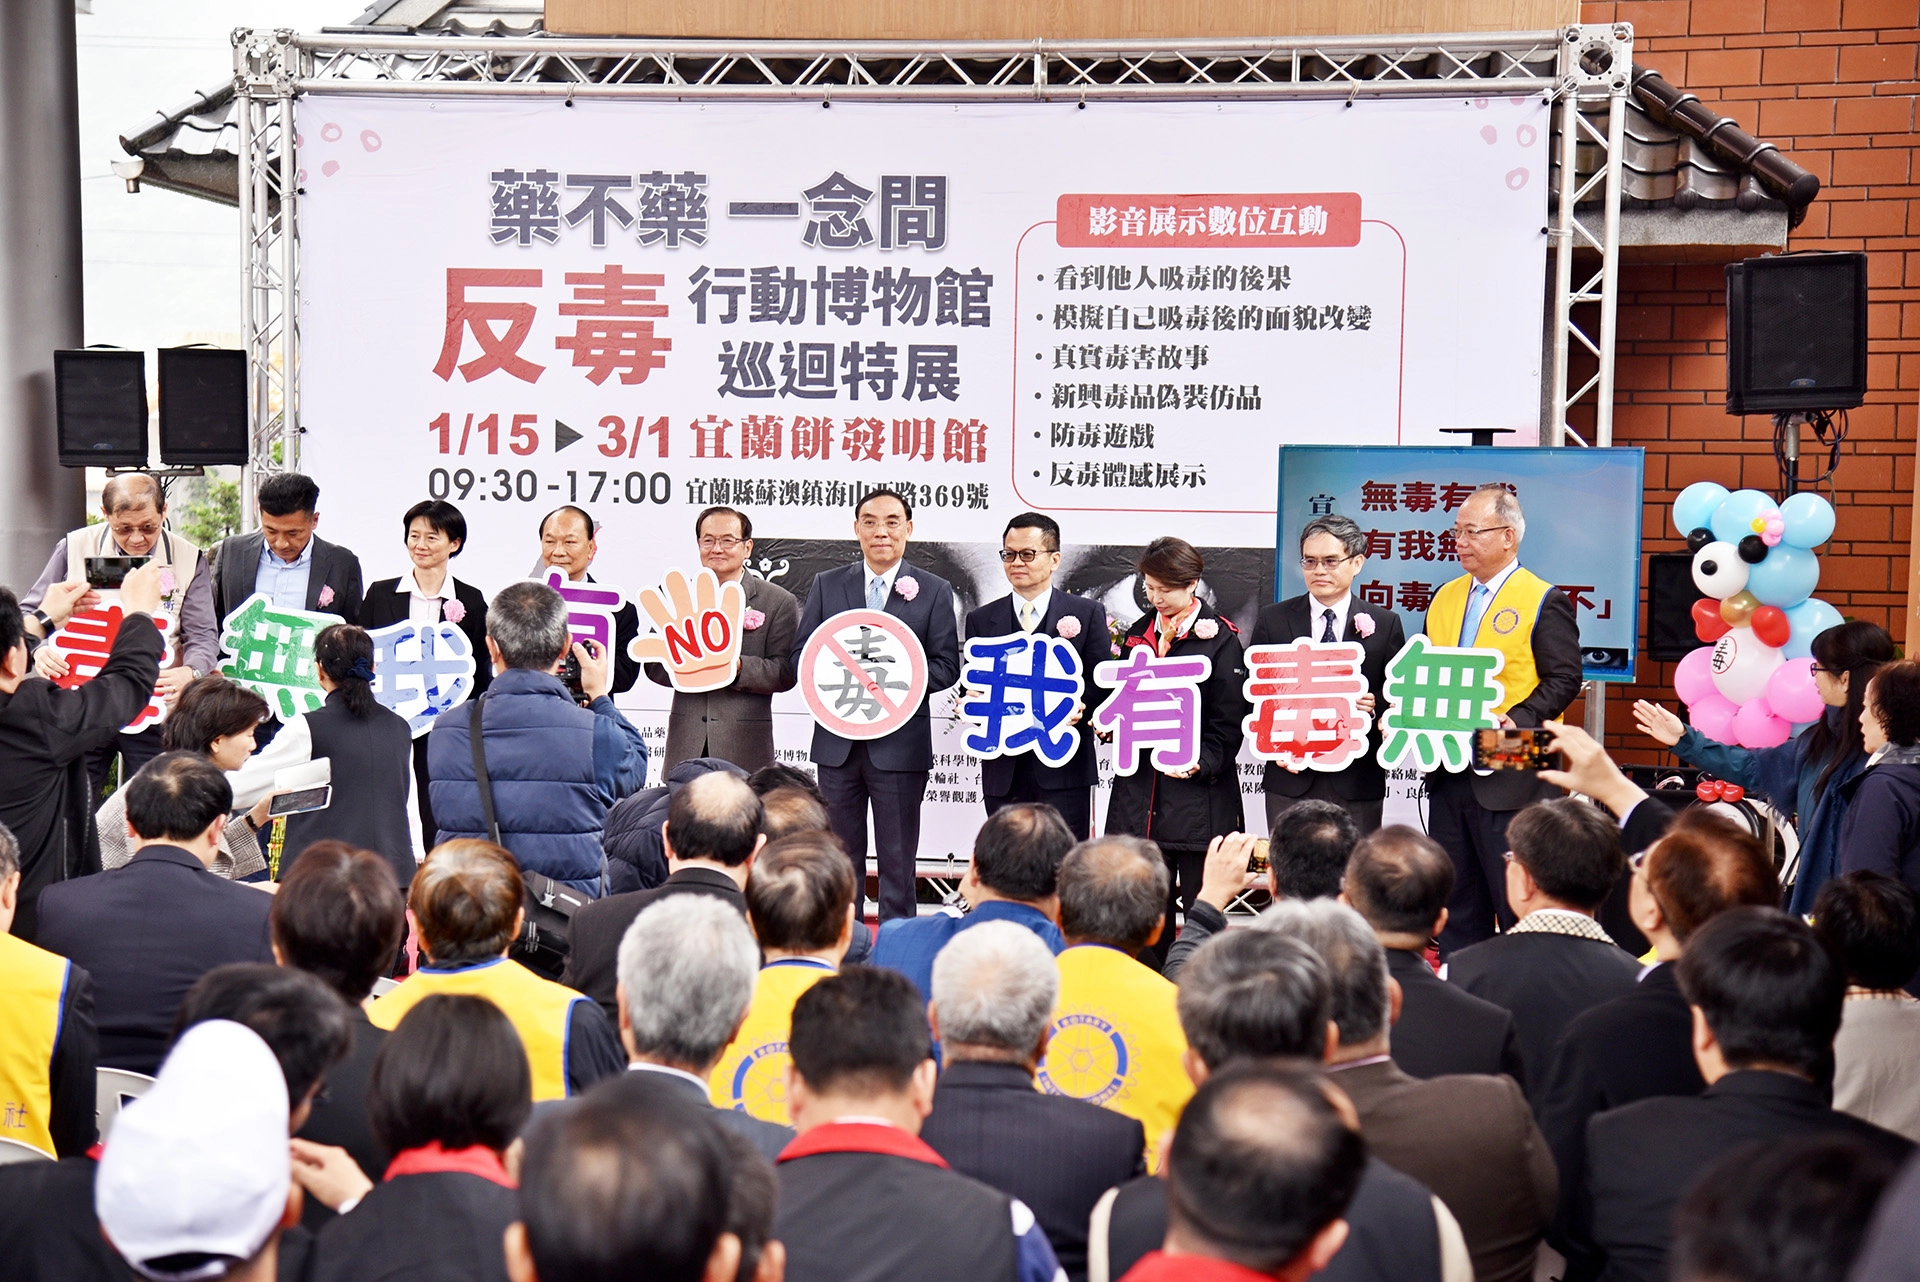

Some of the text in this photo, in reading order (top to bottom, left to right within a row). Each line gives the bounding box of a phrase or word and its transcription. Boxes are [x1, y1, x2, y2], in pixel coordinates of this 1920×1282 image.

[489, 168, 948, 250] 藥不藥 一念間
[1089, 205, 1329, 237] 影音展示數位互動
[687, 264, 994, 328] 行動博物館
[1053, 264, 1291, 292] 看到他人吸毒的後果
[432, 265, 672, 385] 反毒
[1052, 304, 1372, 332] 模擬自己吸毒後的面貌改變
[717, 340, 961, 402] 巡迴特展
[1052, 343, 1210, 371] 真實毒害故事
[1051, 383, 1262, 411] 新興毒品偽裝仿品
[429, 412, 989, 464] 1/15 3/1 宜蘭餅發明館
[1050, 422, 1155, 450] 防毒遊戲
[1049, 462, 1207, 489] 反毒體感展示
[665, 611, 730, 665] NO
[818, 625, 910, 722] 毒
[965, 637, 1079, 762] 我
[1099, 645, 1206, 770] 有
[1248, 643, 1365, 764] 毒
[1383, 640, 1498, 767] 無
[3, 1102, 28, 1128] 社
